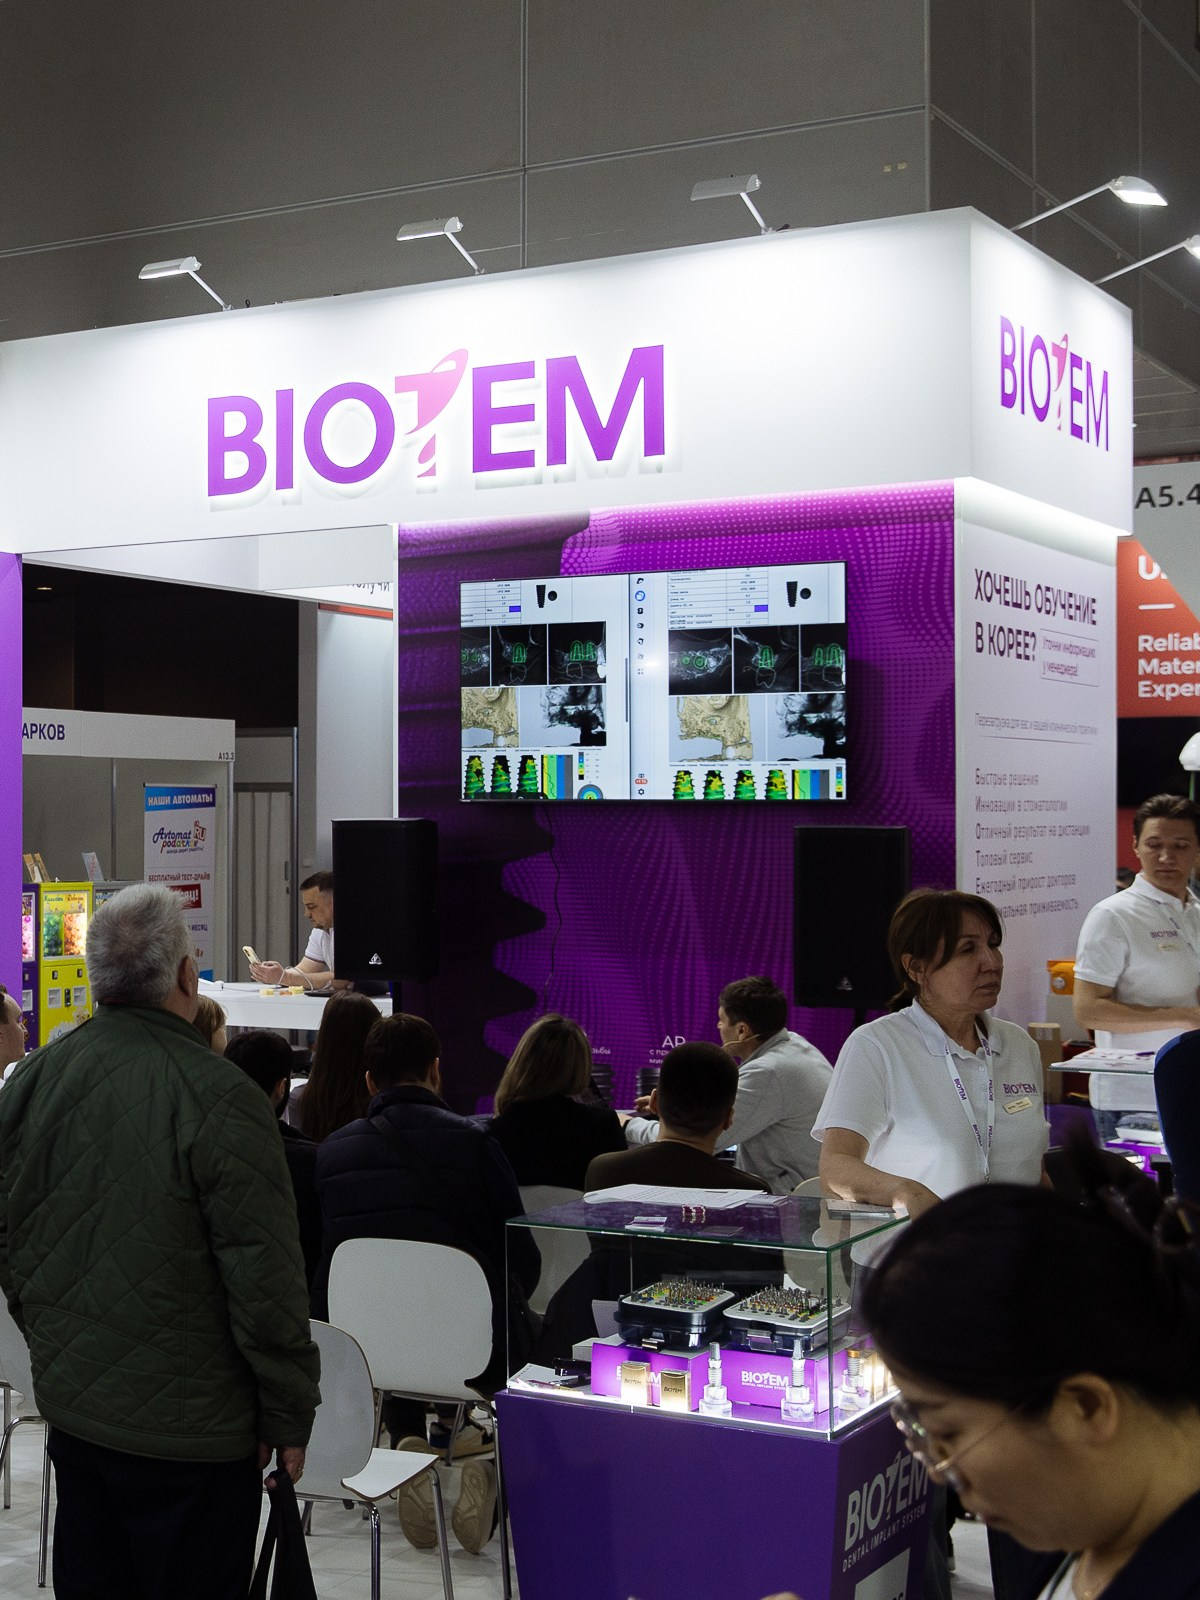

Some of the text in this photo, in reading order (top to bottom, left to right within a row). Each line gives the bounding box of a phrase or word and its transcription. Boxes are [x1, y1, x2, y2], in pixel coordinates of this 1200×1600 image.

[1000, 315, 1108, 451] BIOTEM
[208, 345, 665, 496] BIOTEM
[974, 568, 1097, 626] ХОЧЕШЬ ОБУЧЕНИЕ
[975, 621, 1037, 661] В КОРЕЕ?
[22, 722, 65, 741] АРКОВ
[148, 793, 213, 806] НАШИ АВТОМАТЫ
[1003, 1081, 1039, 1095] BIOTEM
[741, 1370, 789, 1387] BIOTEM
[844, 1450, 929, 1552] BIOTEM
[842, 1502, 926, 1573] DENTAL IMPLANT SYSTEM
